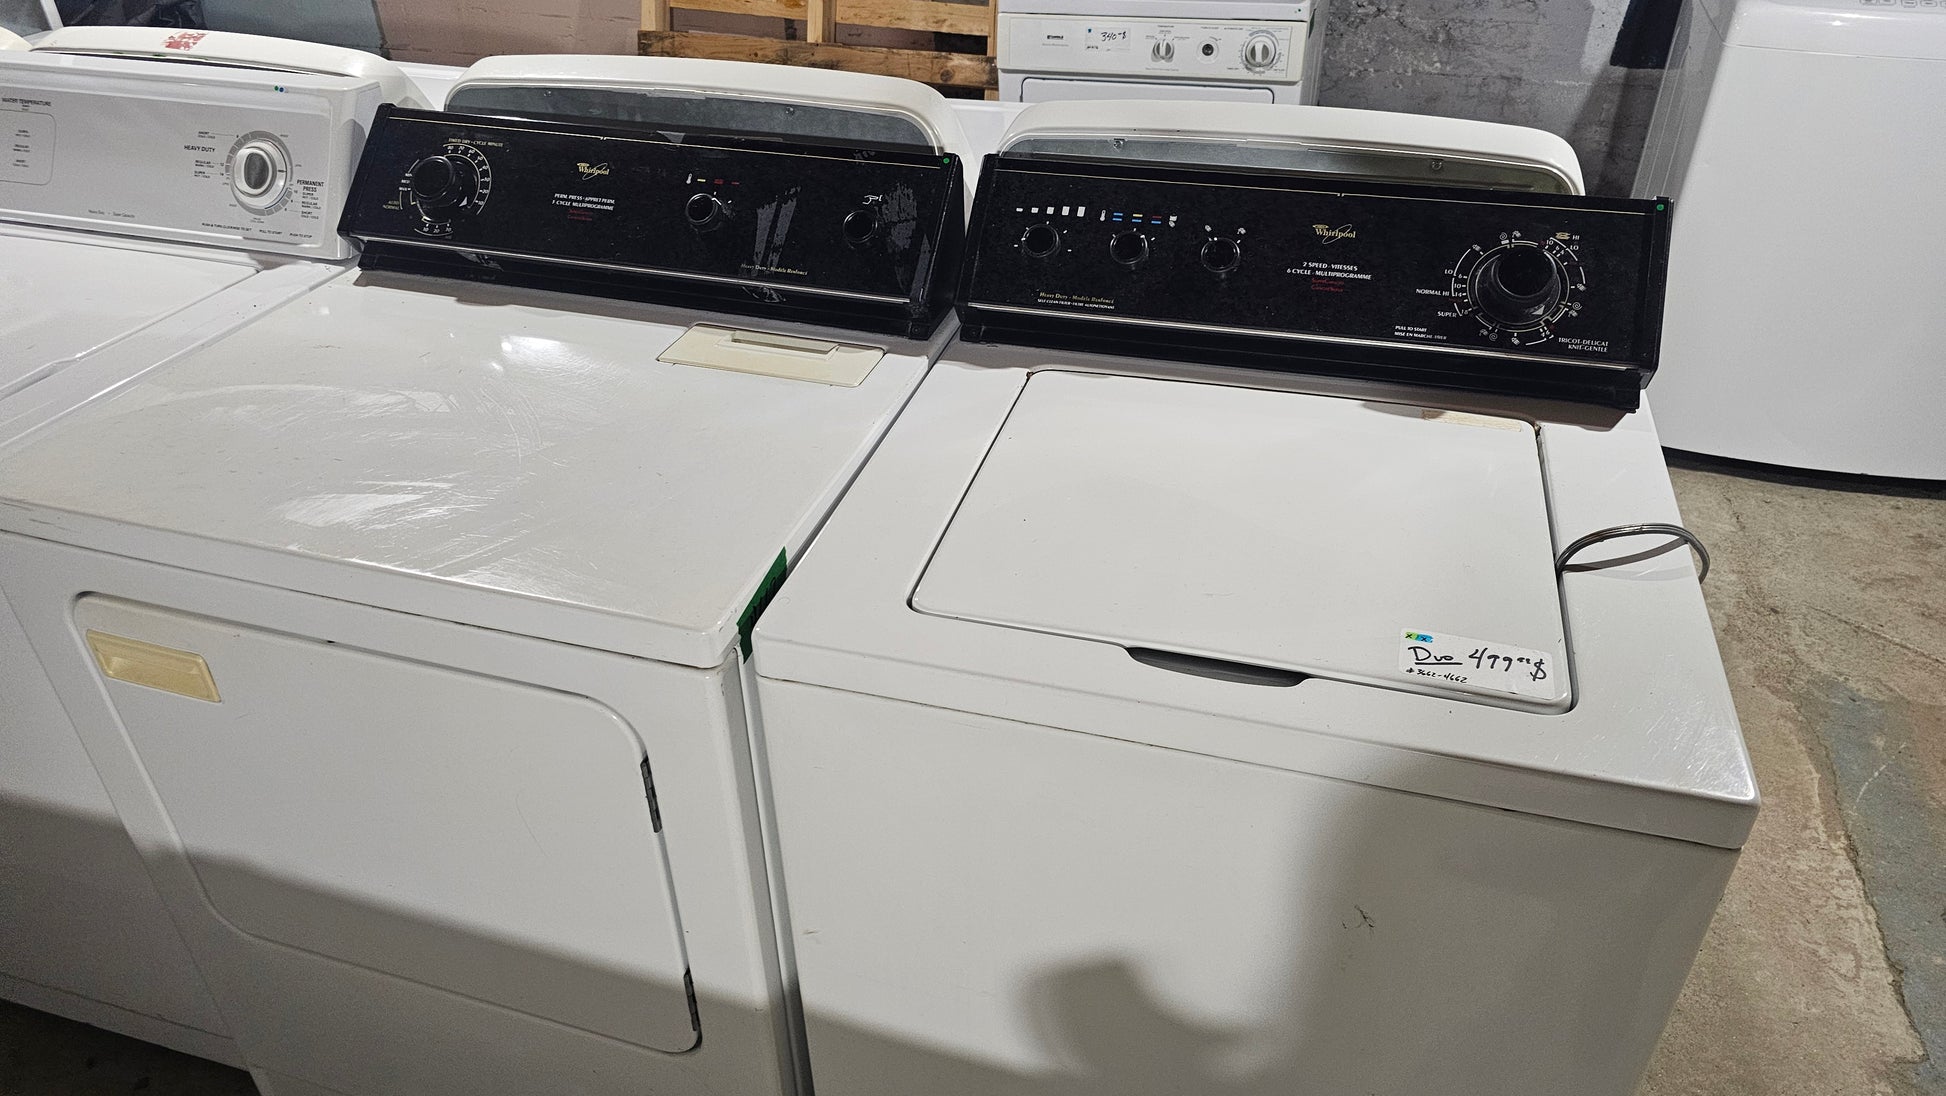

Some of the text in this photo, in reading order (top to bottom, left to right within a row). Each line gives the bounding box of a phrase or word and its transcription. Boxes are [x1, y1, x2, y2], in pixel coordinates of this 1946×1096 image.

[1312, 224, 1356, 240] Whirlpool
[1308, 261, 1328, 269] SPEED
[1331, 263, 1358, 272] VITESSES
[1315, 270, 1372, 280] MULTIPROGRAMME
[1415, 288, 1441, 296] NORMAL
[1437, 310, 1457, 318] SUPER
[1407, 646, 1454, 661] Duo
